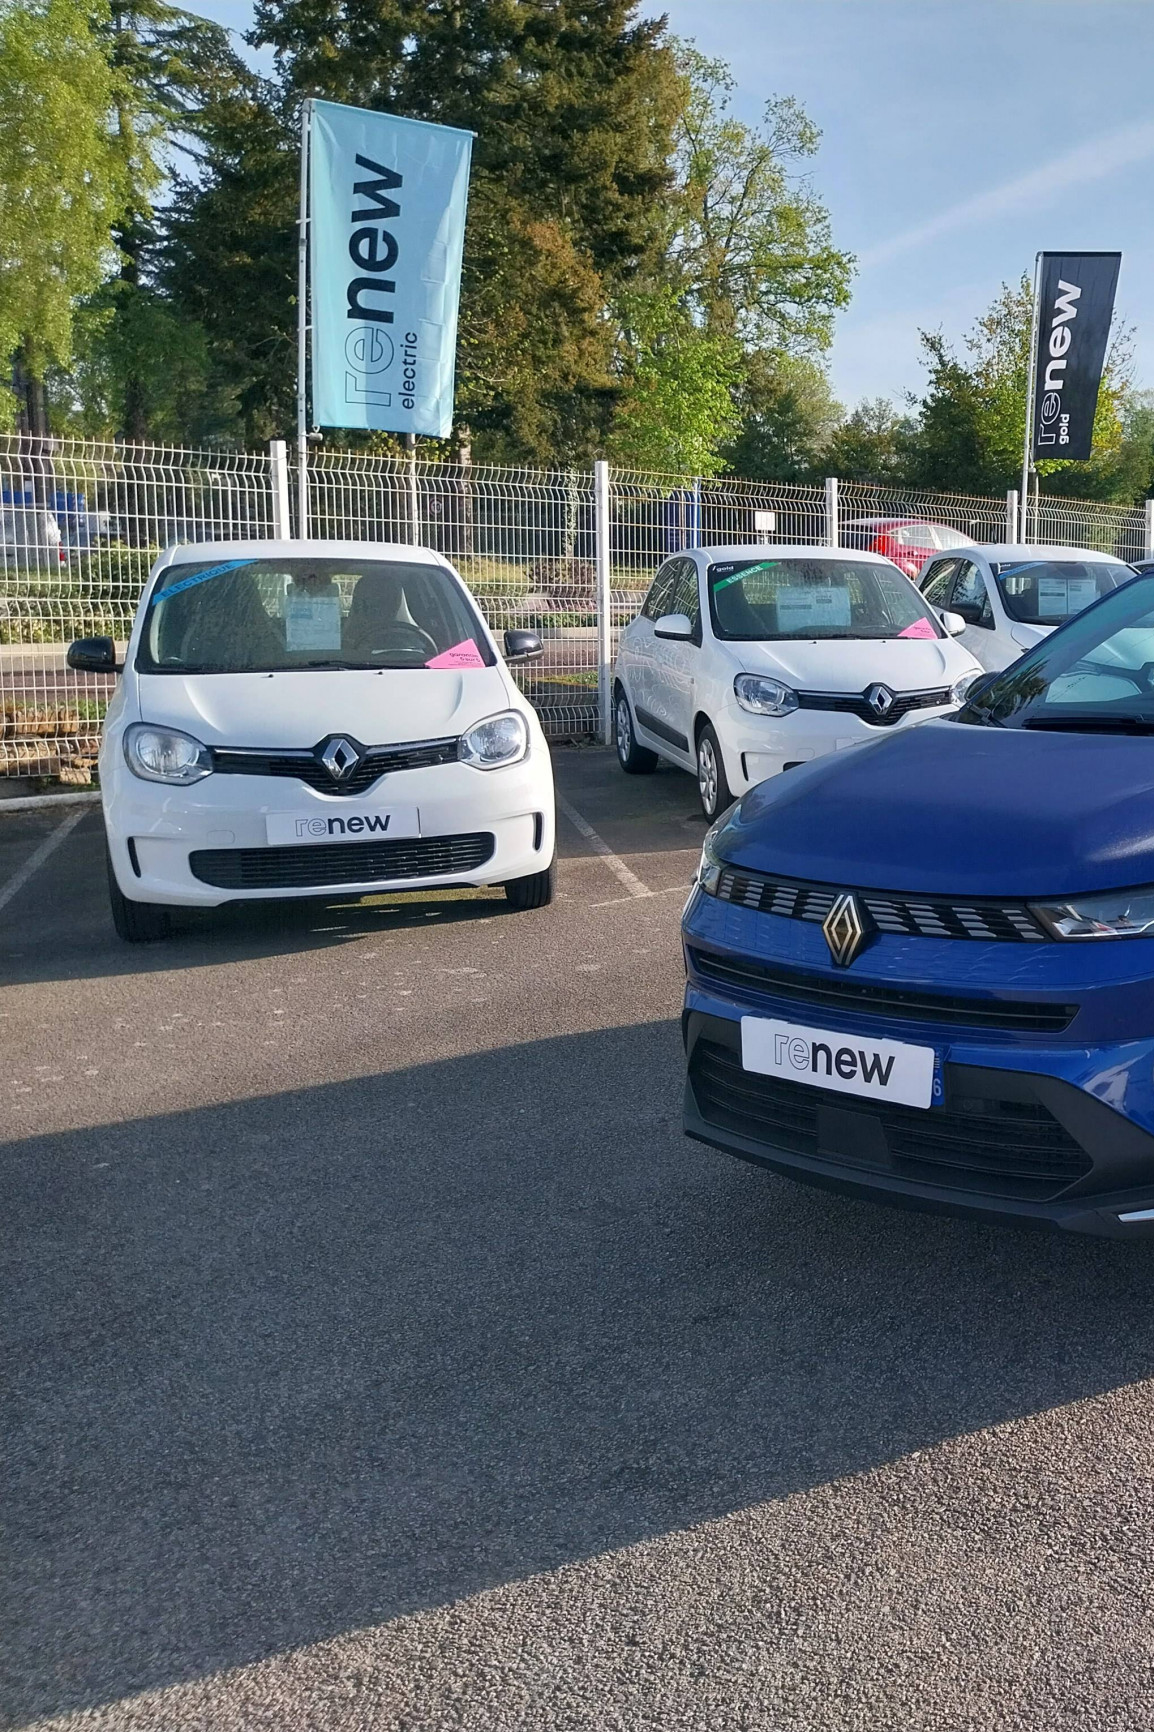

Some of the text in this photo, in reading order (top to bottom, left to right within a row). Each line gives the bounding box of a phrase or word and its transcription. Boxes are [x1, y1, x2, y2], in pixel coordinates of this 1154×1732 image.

[344, 153, 404, 407] renew
[398, 331, 418, 410] electric
[1038, 279, 1082, 446] renew
[1058, 413, 1070, 445] gold
[295, 815, 391, 837] renew
[774, 1033, 896, 1087] renew
